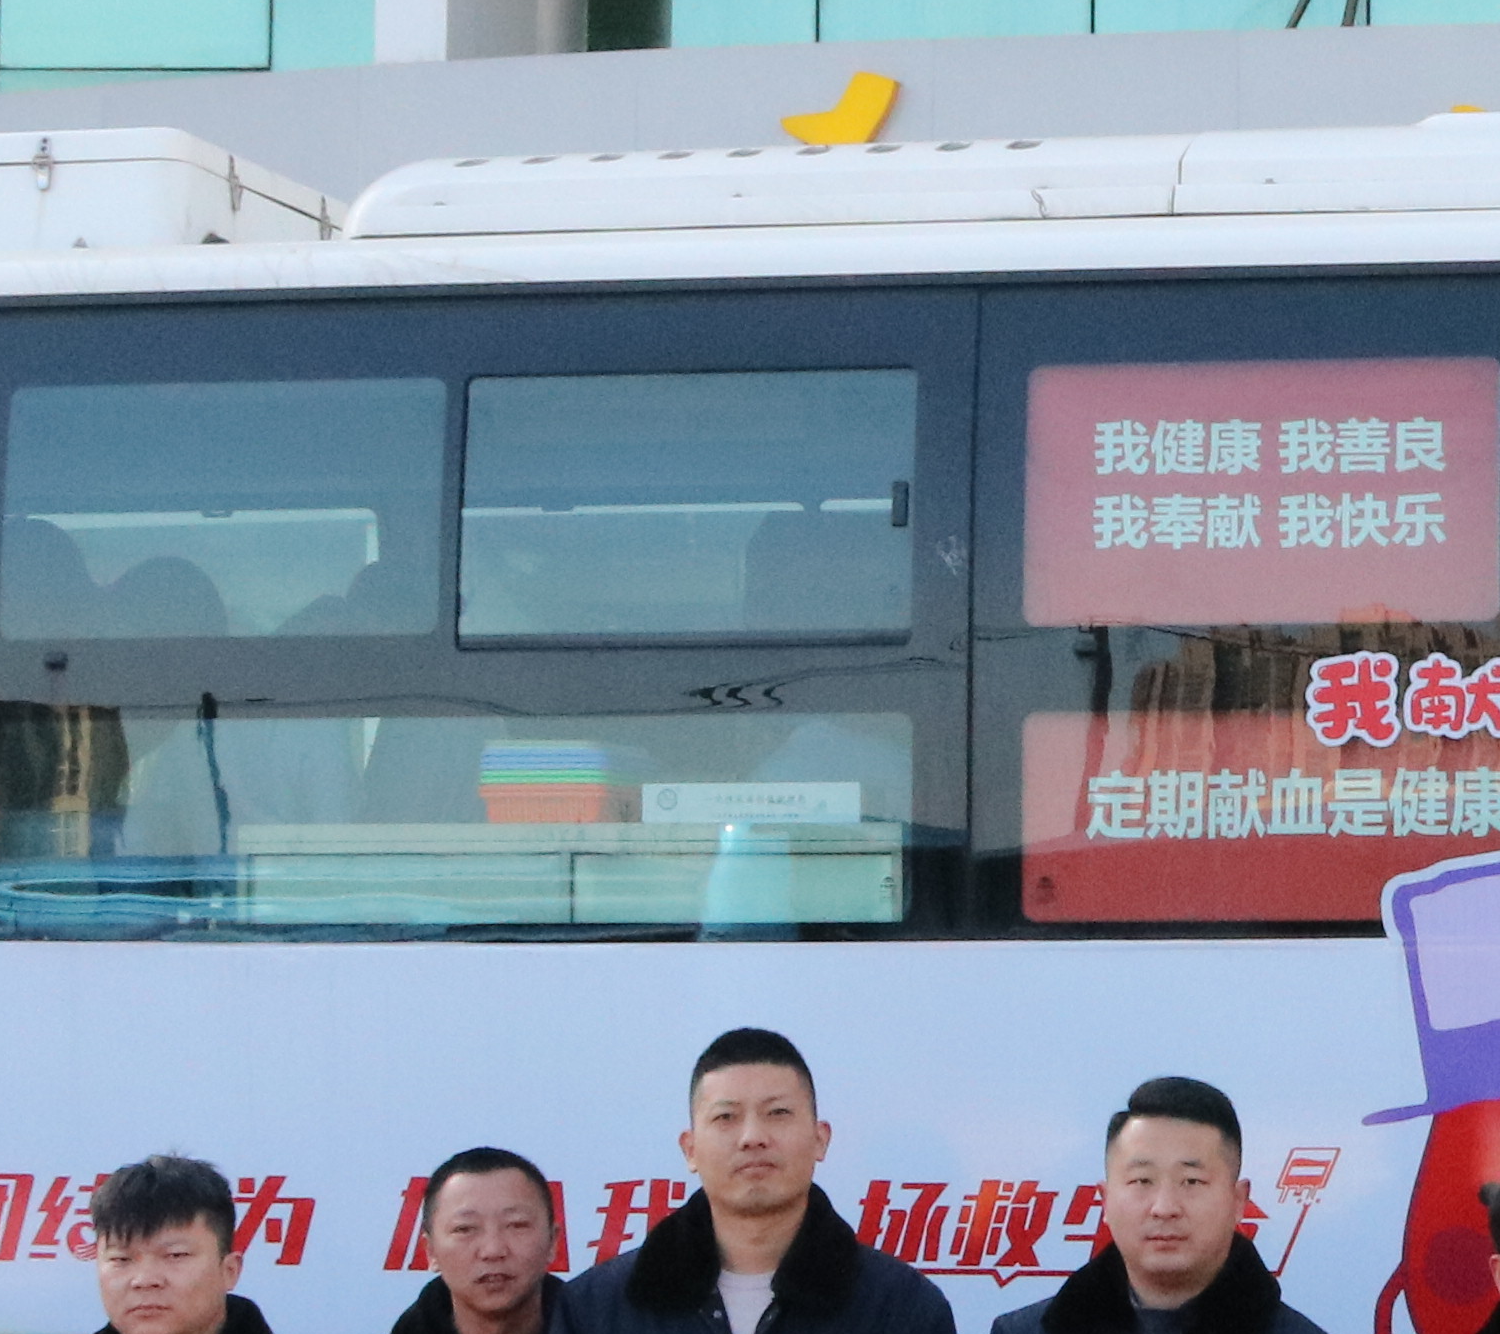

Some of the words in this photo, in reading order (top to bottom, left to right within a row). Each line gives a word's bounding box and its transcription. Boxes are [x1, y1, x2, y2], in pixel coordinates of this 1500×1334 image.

[1094, 419, 1261, 475] 我健康
[1278, 417, 1446, 473] 我善良
[1093, 493, 1261, 550] 我奉献
[1278, 493, 1446, 548] 我快乐
